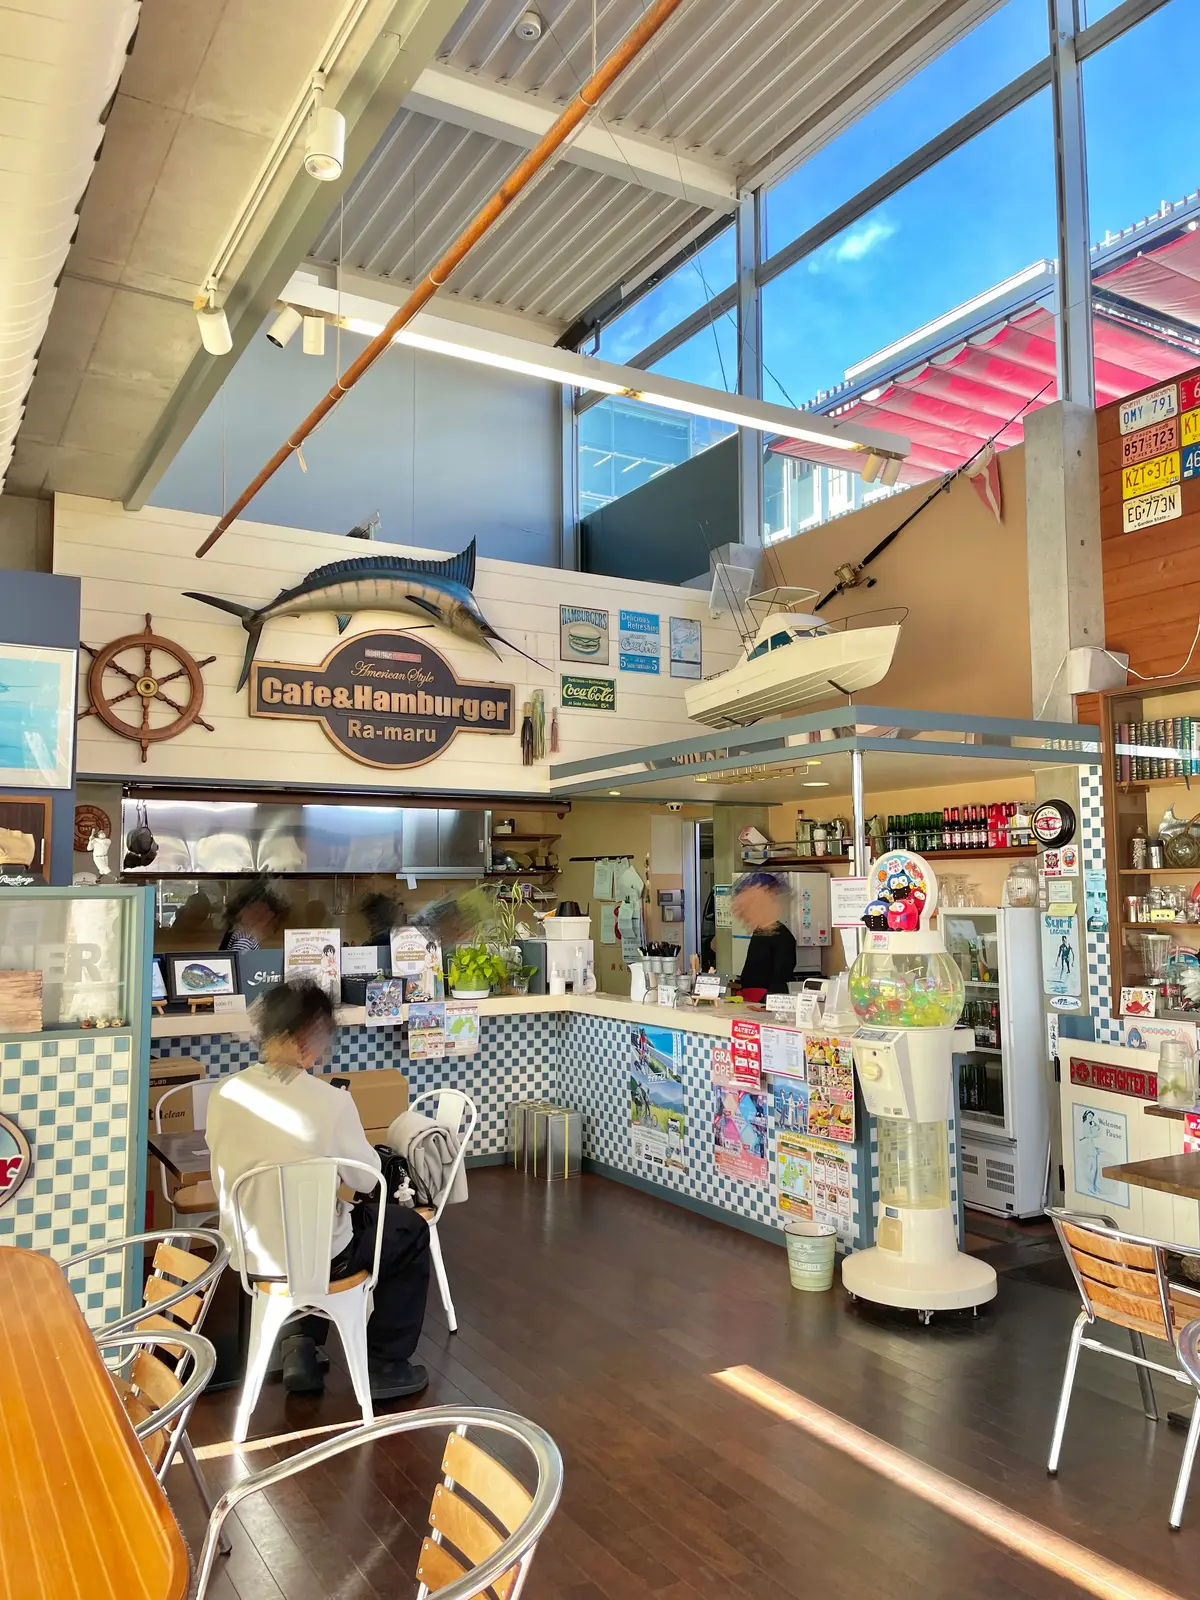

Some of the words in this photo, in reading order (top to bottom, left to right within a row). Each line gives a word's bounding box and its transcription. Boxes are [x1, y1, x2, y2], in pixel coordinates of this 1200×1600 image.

[1123, 406, 1143, 425] OMY
[1152, 394, 1172, 414] 791
[1124, 438, 1145, 457] 857
[1152, 427, 1175, 447] 723
[1125, 465, 1146, 489] KZT
[1154, 457, 1176, 480] 371
[1137, 519, 1153, 527] Garden
[562, 607, 607, 630] HAMBURGERS
[621, 612, 650, 623] Delicious
[627, 621, 659, 634] Refreshing
[350, 660, 407, 681] American
[406, 667, 435, 688] Style
[261, 676, 508, 722] Cafe&Hamburger
[347, 719, 436, 743] Ra-maru
[1045, 915, 1073, 929] Surf
[714, 1050, 732, 1063] GRA
[714, 1063, 732, 1077] OPE
[1091, 1065, 1147, 1095] FIREFIGHTER
[164, 1110, 186, 1119] clean
[1097, 1118, 1122, 1131] Welcome
[1105, 1128, 1122, 1140] Pause
